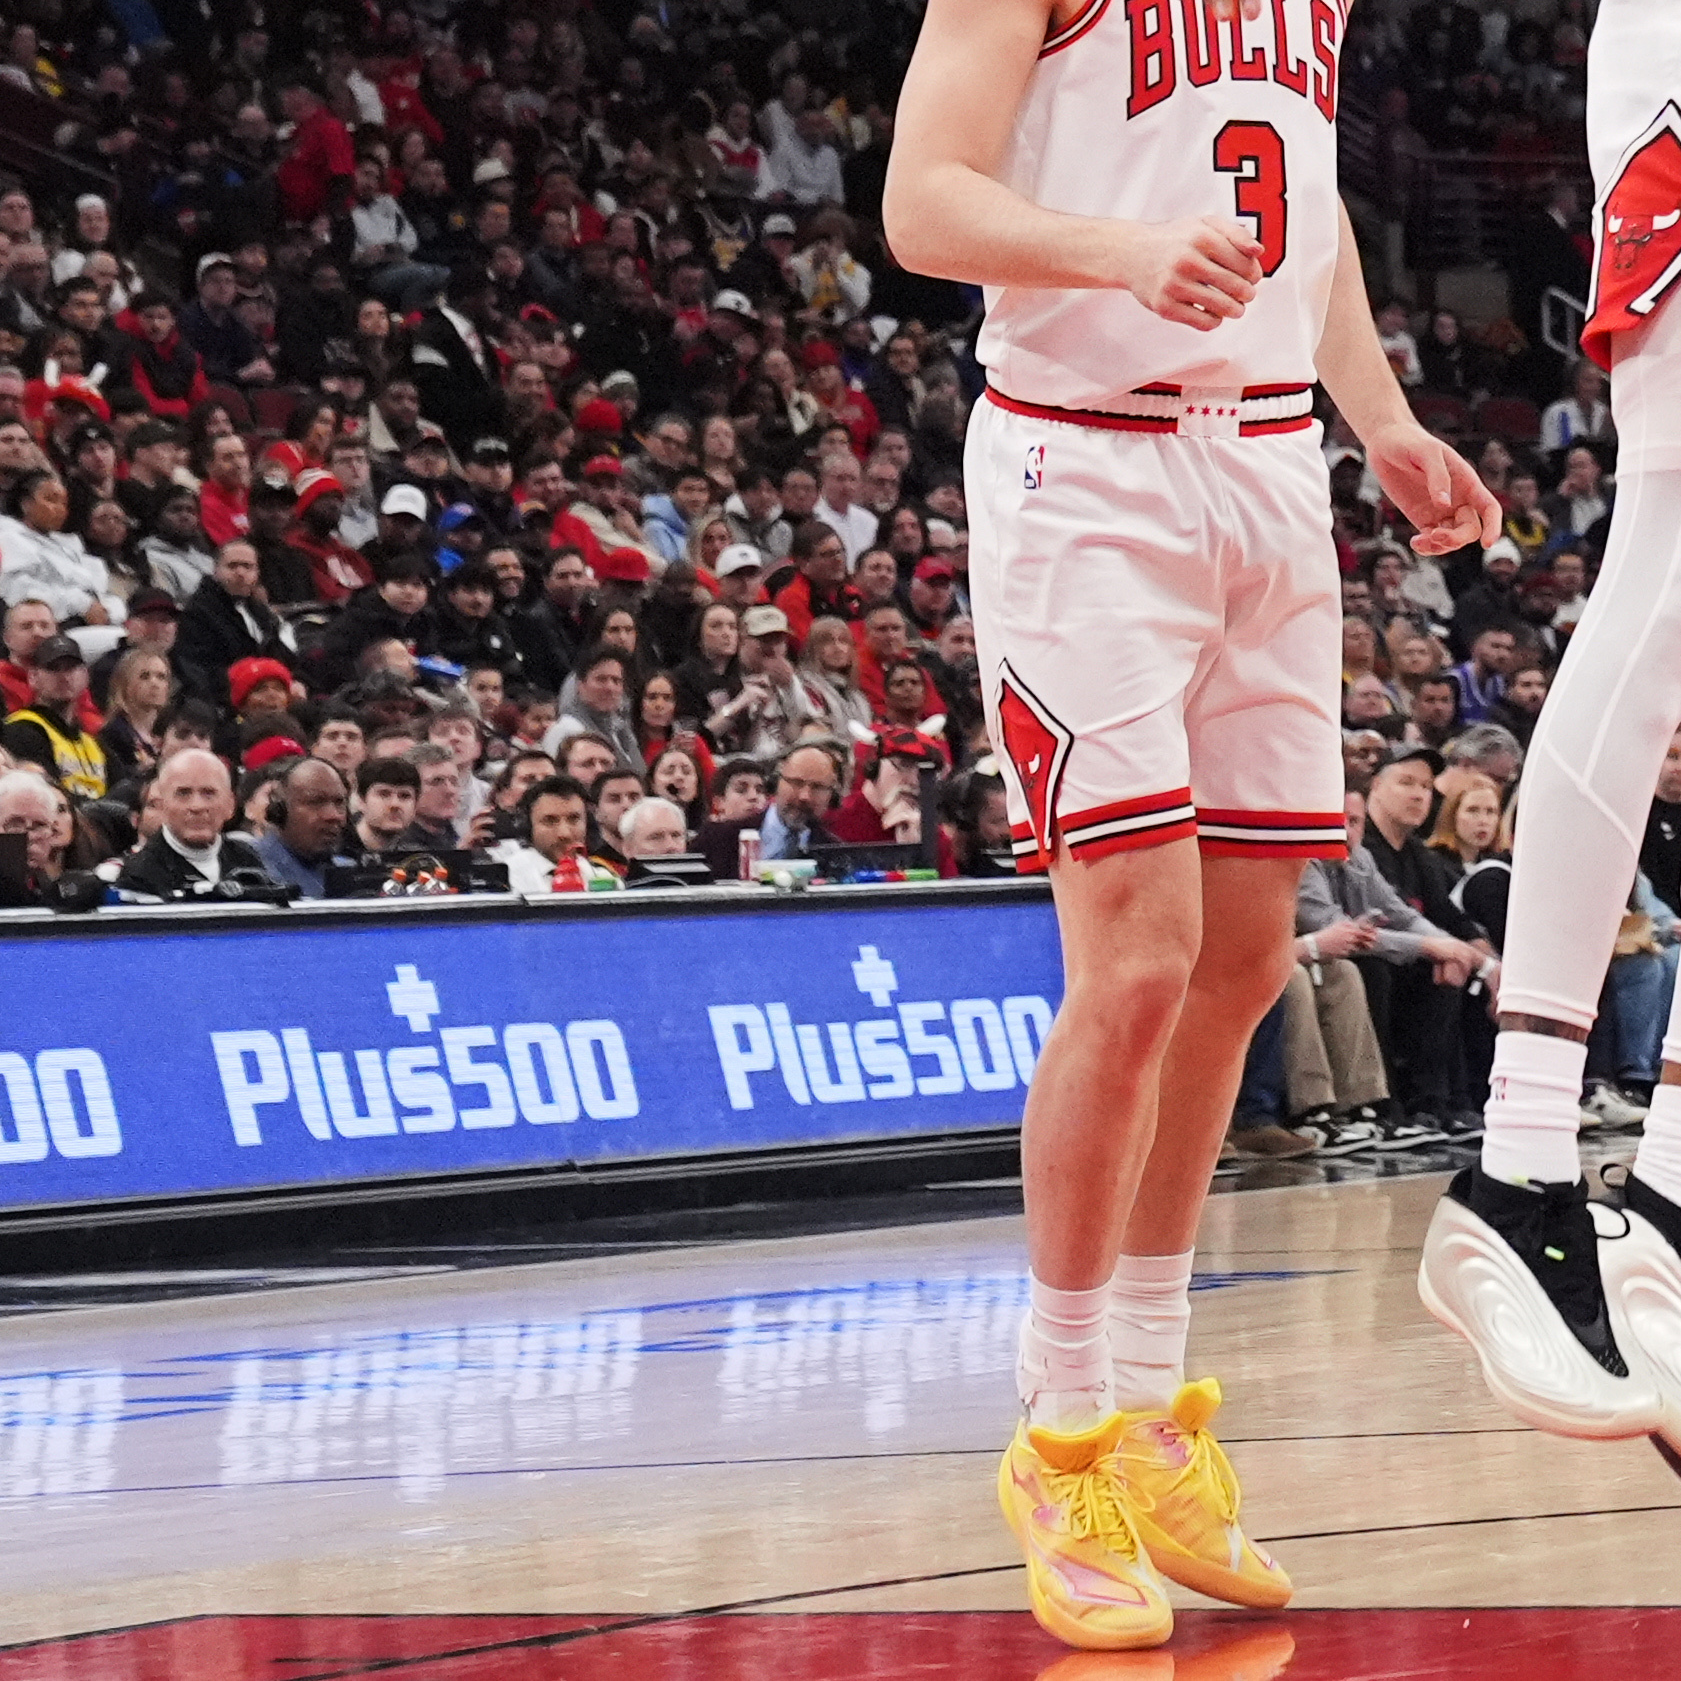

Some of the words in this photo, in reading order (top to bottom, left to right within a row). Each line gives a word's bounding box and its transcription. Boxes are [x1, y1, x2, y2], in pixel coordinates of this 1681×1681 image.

[1212, 119, 1288, 278] 3
[210, 1020, 641, 1148] Plus500
[708, 995, 1053, 1112] Plus500
